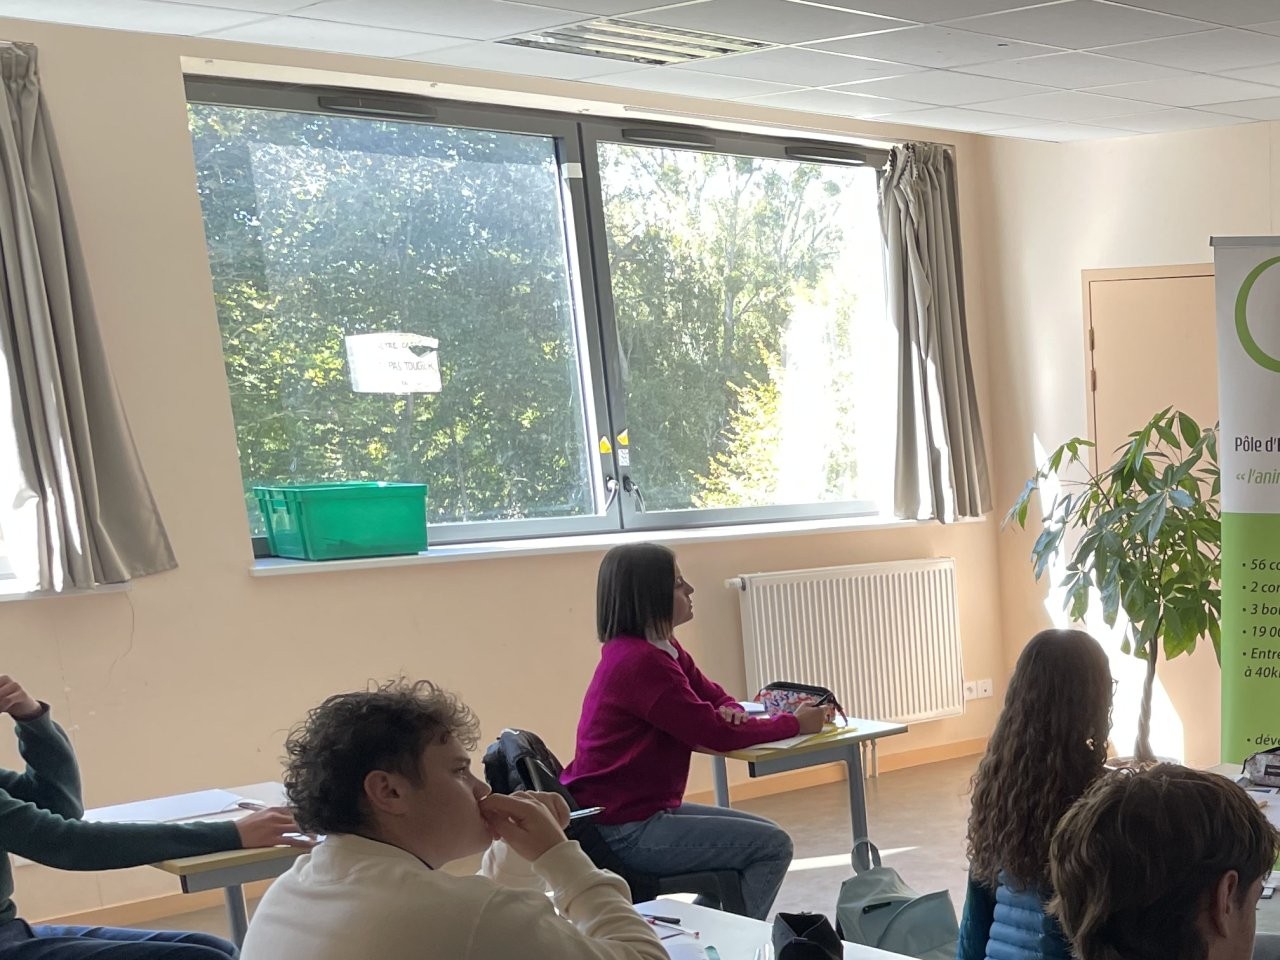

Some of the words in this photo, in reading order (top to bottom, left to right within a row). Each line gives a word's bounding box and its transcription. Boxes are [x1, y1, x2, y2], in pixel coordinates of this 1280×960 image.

[1234, 435, 1262, 452] Pôle
[1250, 558, 1266, 570] 56
[1250, 581, 1258, 593] 2
[1250, 603, 1258, 615] 3
[1244, 665, 1252, 677] à
